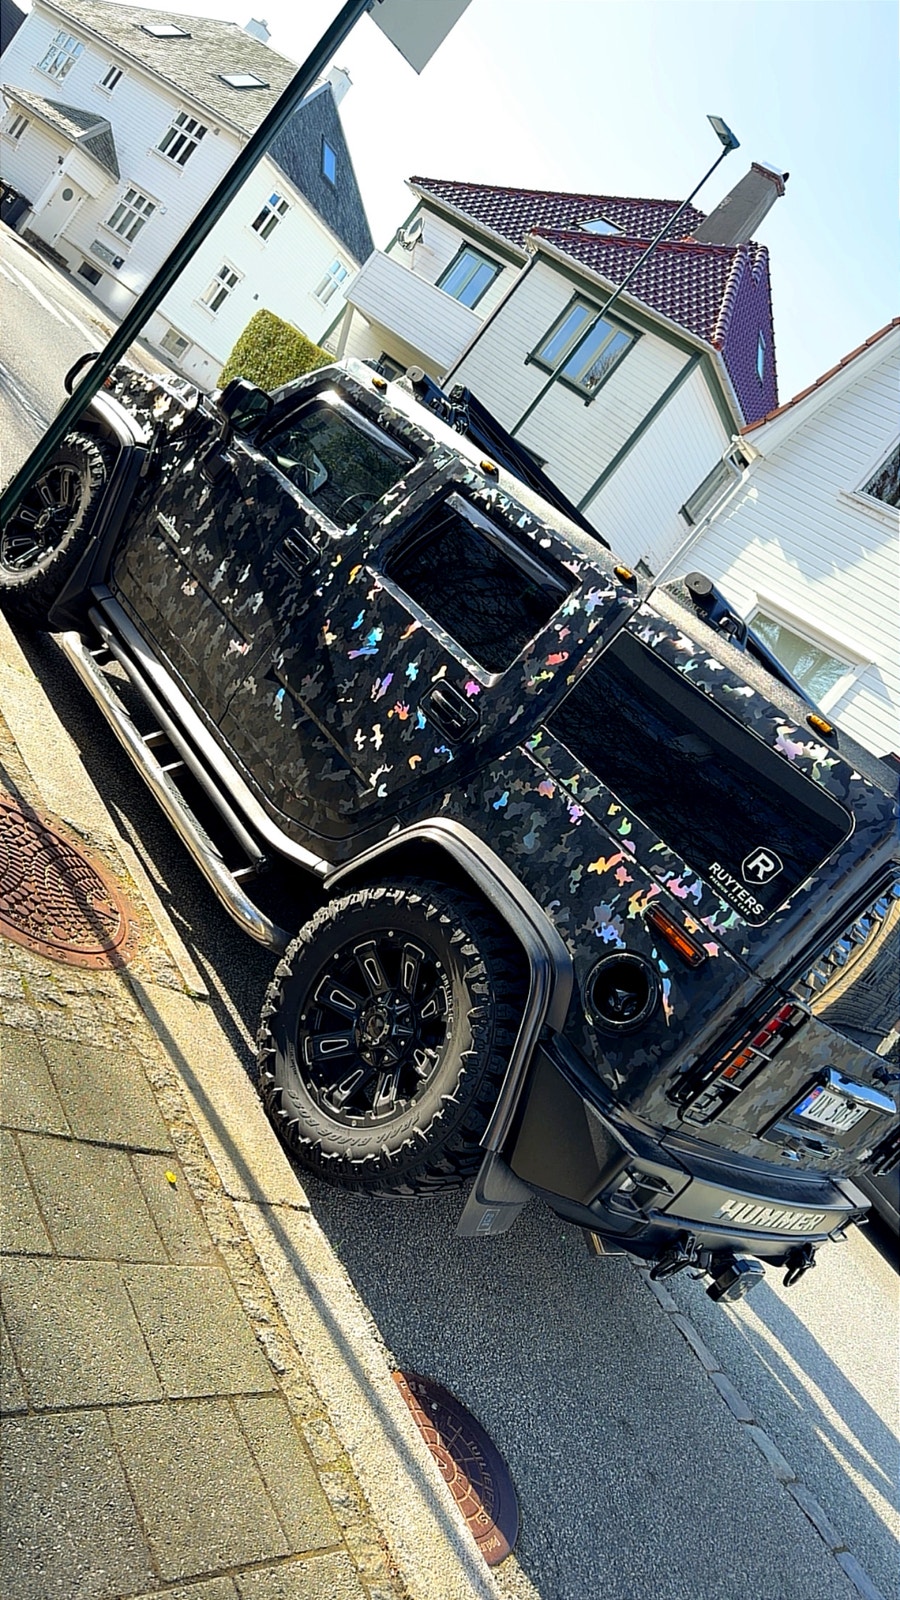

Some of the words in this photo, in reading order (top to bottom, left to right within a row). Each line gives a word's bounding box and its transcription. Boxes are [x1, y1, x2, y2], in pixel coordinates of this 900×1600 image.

[746, 852, 775, 880] R
[708, 862, 764, 915] RUYTERS
[808, 1094, 836, 1118] UX
[712, 1199, 826, 1231] HUMMER
